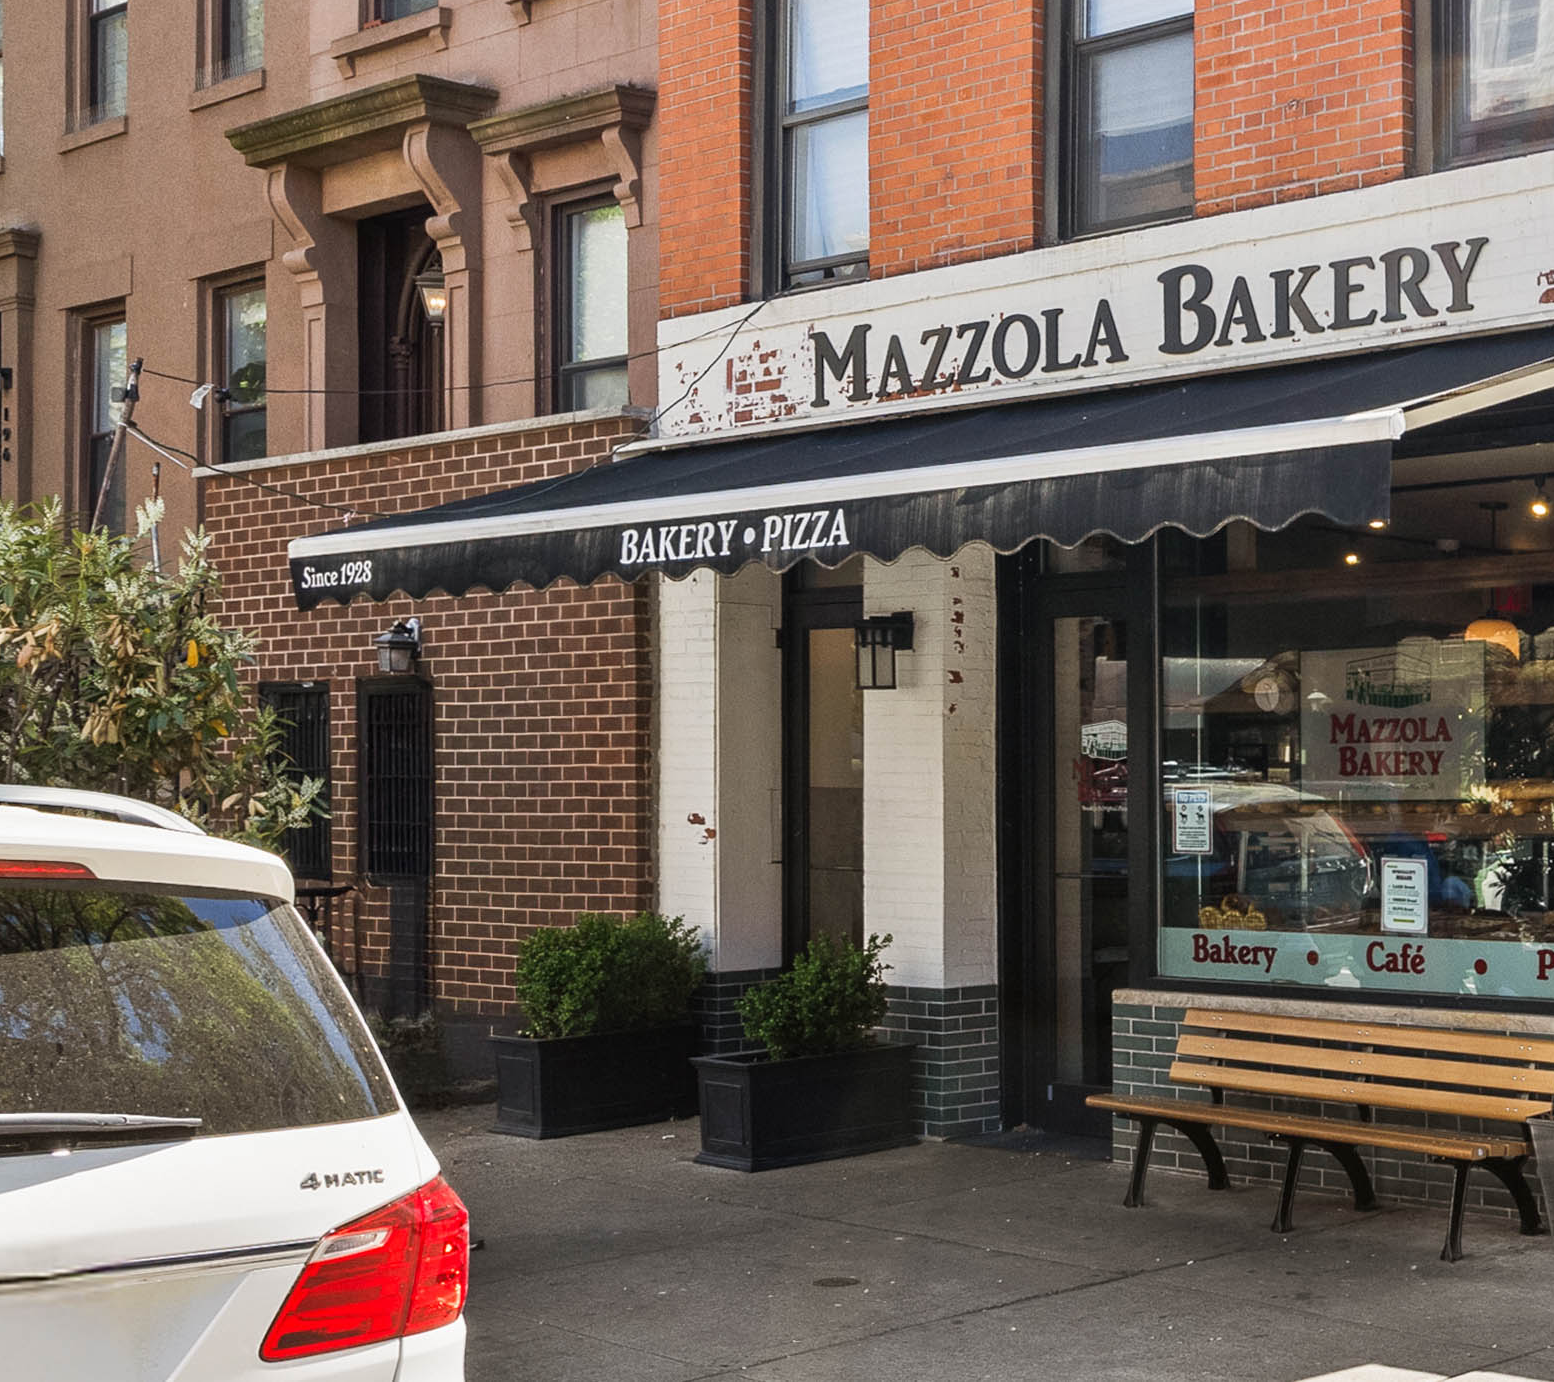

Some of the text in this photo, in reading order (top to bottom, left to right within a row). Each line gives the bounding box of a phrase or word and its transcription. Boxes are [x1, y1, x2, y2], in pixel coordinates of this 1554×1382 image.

[809, 236, 1489, 408] MAZZOLA BAKERY
[619, 508, 850, 564] BAKERY PIZZA
[301, 560, 372, 588] Since 1928
[1329, 713, 1453, 744] MAZZOLA
[1339, 746, 1445, 777] BAKERY
[1192, 933, 1277, 973] Bakery
[1366, 940, 1426, 974] Café
